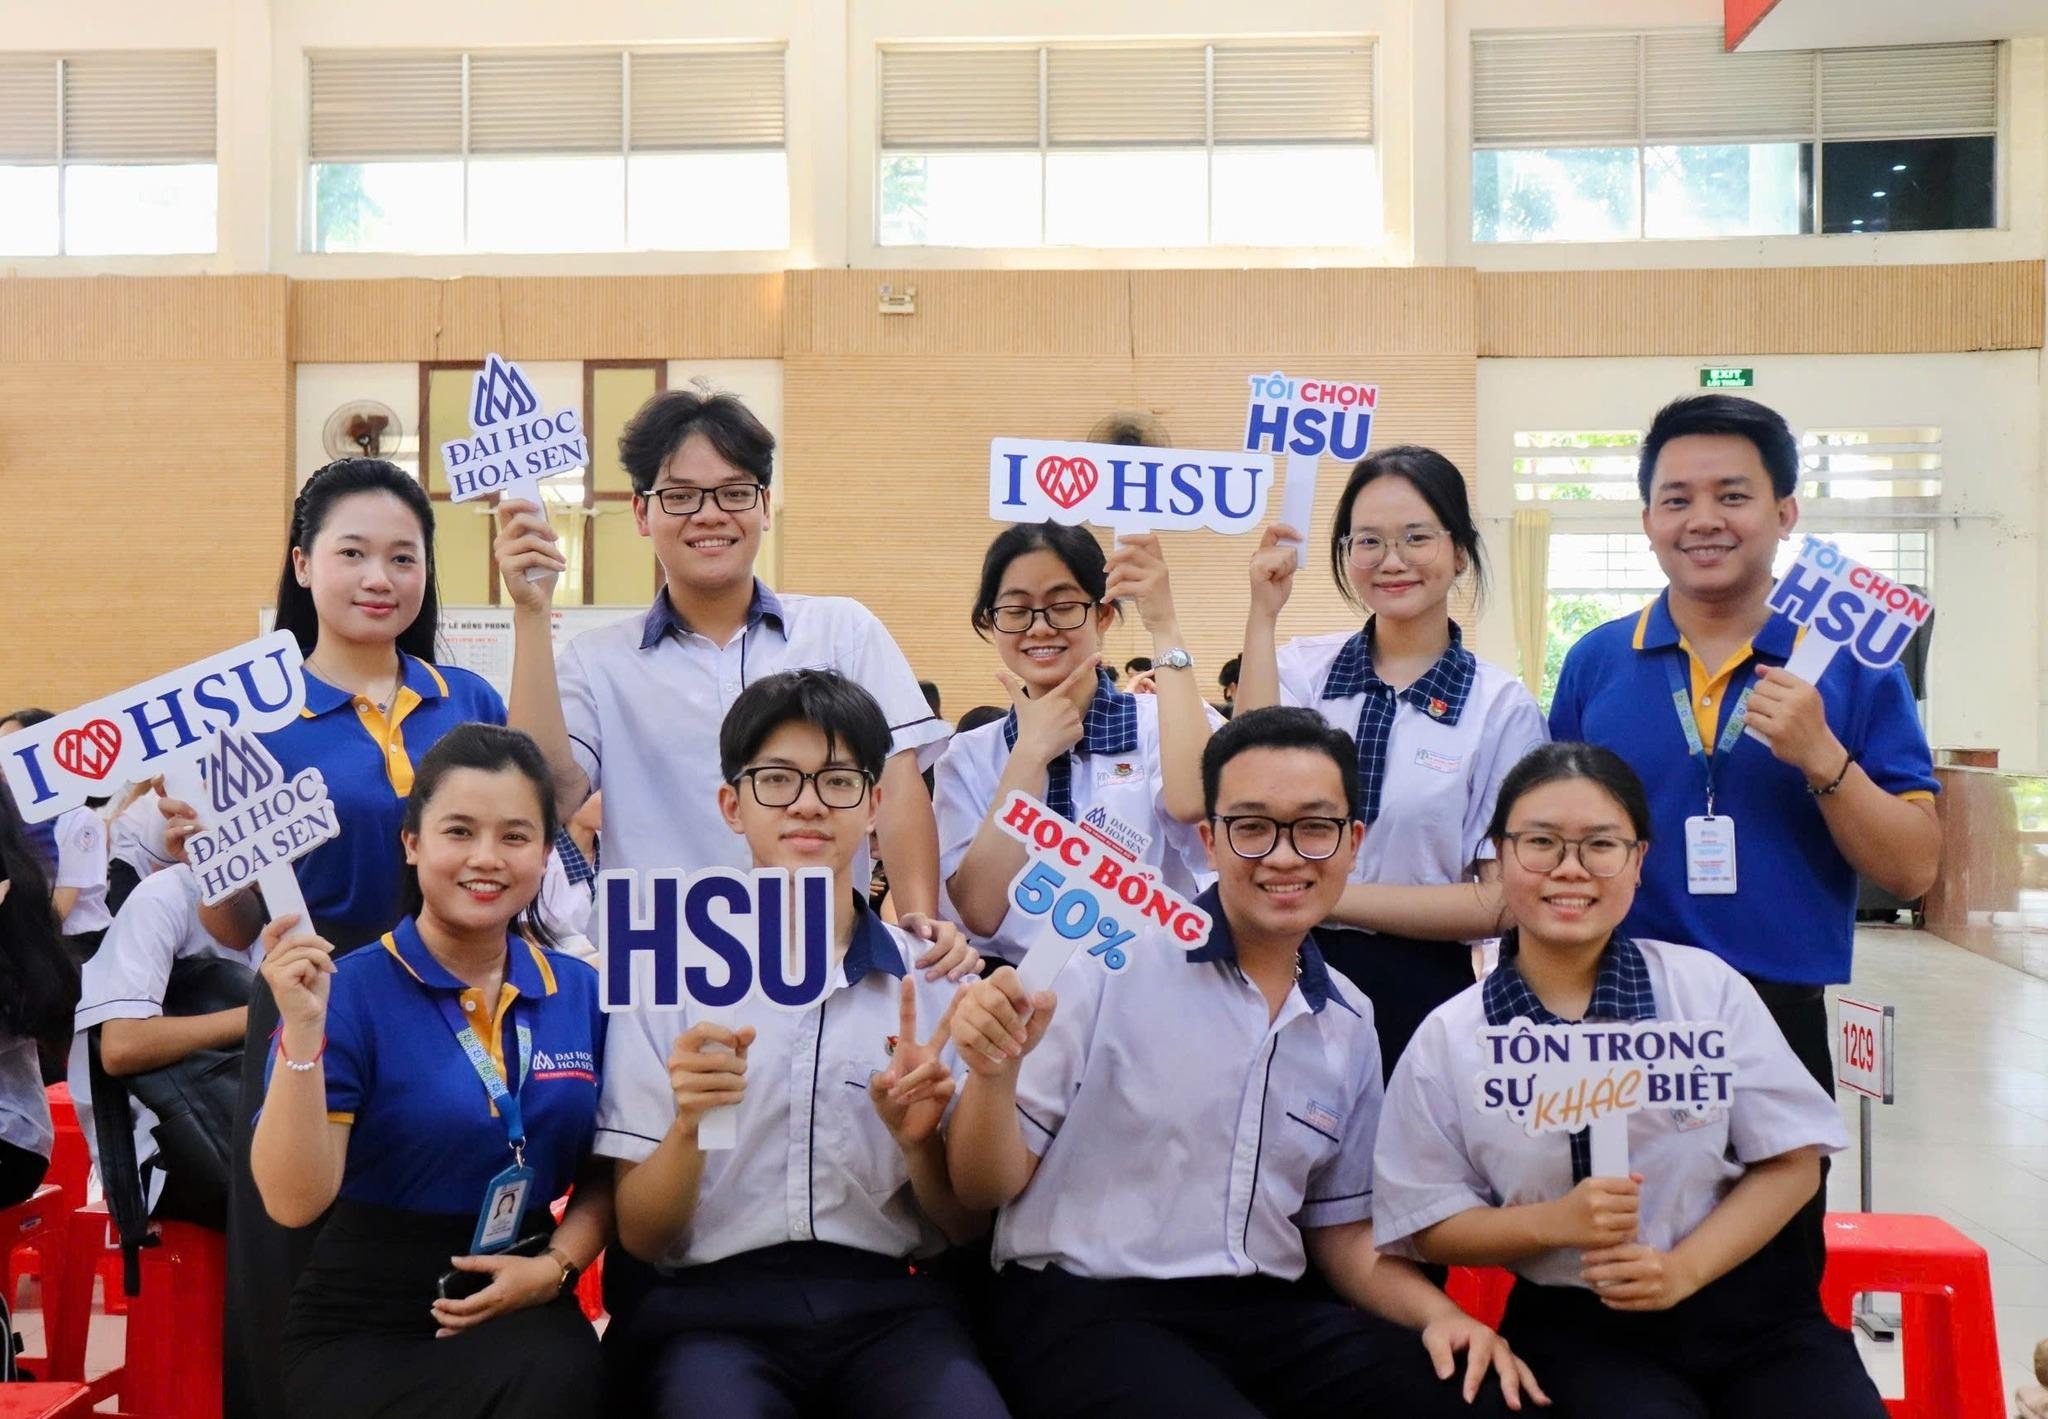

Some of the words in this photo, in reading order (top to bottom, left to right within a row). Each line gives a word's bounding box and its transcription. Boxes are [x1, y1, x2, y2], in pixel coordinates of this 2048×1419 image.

[1252, 374, 1294, 401] TÔI
[1300, 382, 1376, 411] CHỌN
[447, 432, 502, 466] ĐẠI
[506, 411, 577, 449] HỌC
[453, 459, 522, 497] HOA
[526, 439, 584, 475] SEN
[1246, 404, 1371, 460] HSU
[1002, 454, 1028, 506] I
[1106, 459, 1263, 519] HSU
[1769, 563, 1912, 665] HSU
[1801, 536, 1848, 576] TÔI
[1849, 567, 1930, 622] CHỌN
[13, 744, 59, 804] I
[122, 648, 295, 762] HSU
[190, 816, 245, 866] ĐẠI
[246, 774, 319, 833] HỌC
[201, 845, 272, 899] HOA
[271, 807, 332, 858] SEN
[1105, 826, 1124, 844] HOA
[1125, 840, 1144, 855] SEN
[1003, 799, 1090, 867] HỌC
[1089, 855, 1205, 942] BỔNG
[607, 876, 827, 1007] HSU
[1015, 861, 1136, 970] 50%
[1486, 1027, 1570, 1064] TÔN
[1583, 1030, 1725, 1069] TRỌNG
[1484, 1074, 1537, 1116] SỰ
[1534, 1068, 1642, 1129] KHÁC
[1648, 1065, 1732, 1110] BIỆT
